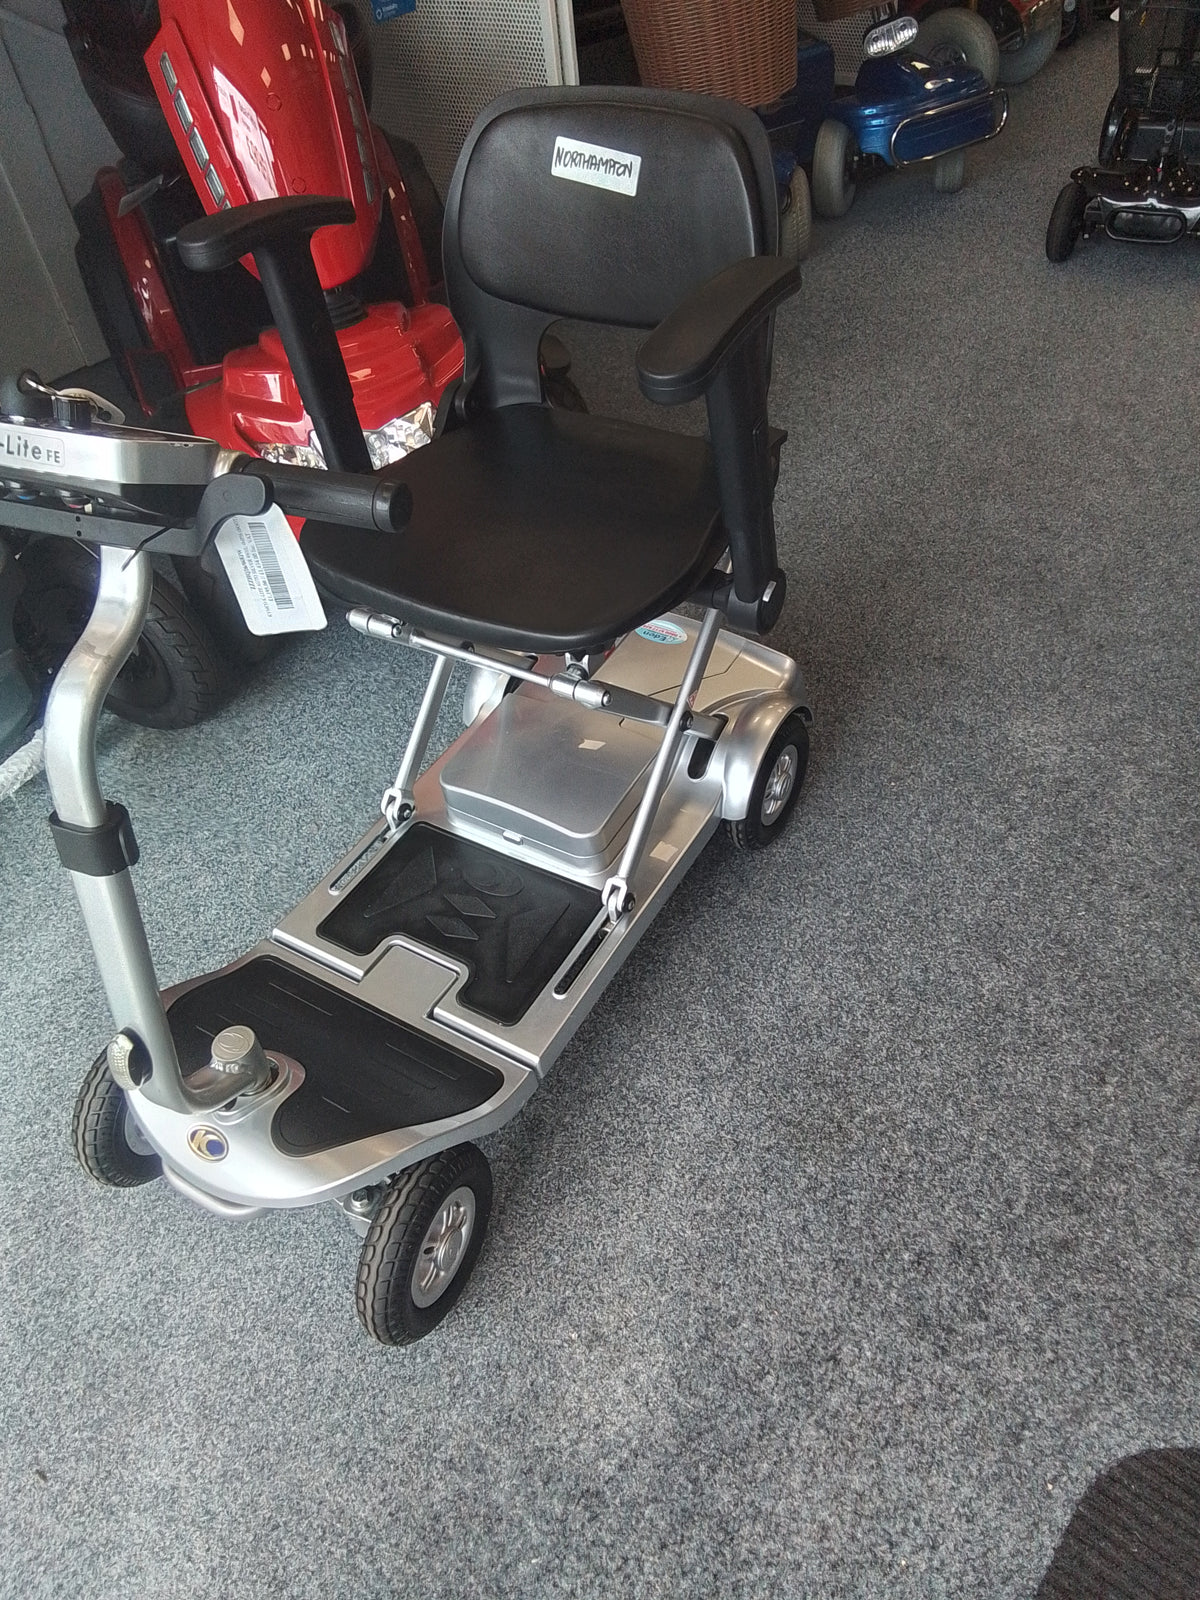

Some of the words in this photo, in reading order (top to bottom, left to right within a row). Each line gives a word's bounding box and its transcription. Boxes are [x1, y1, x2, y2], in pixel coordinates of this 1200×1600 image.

[554, 145, 633, 179] NORTHAMPTON
[46, 449, 61, 463] FE
[642, 630, 667, 642] Eden
